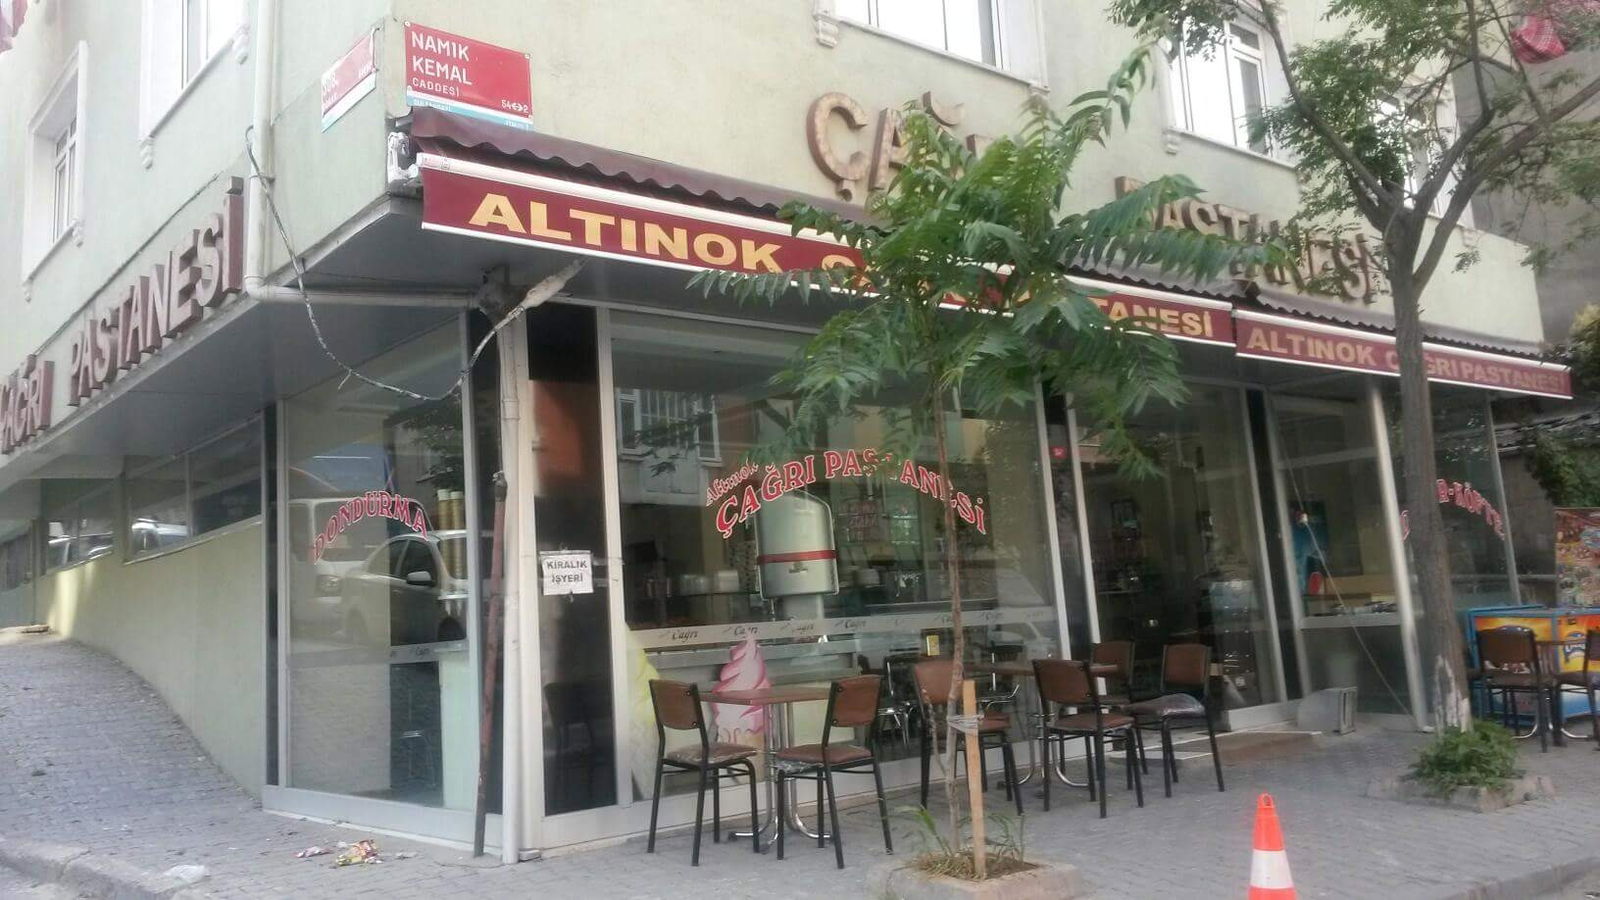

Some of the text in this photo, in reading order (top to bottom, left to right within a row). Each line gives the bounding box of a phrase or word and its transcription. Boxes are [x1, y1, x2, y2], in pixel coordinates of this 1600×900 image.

[411, 31, 469, 61] NAMIK
[412, 55, 473, 86] KEMAL
[468, 192, 783, 274] ALTINOK
[0, 176, 244, 455] AĞRI PASTANESİ
[1246, 328, 1377, 367] ALTINOK
[312, 489, 430, 566] DONDURMA
[715, 455, 817, 539] ÇAĞRI
